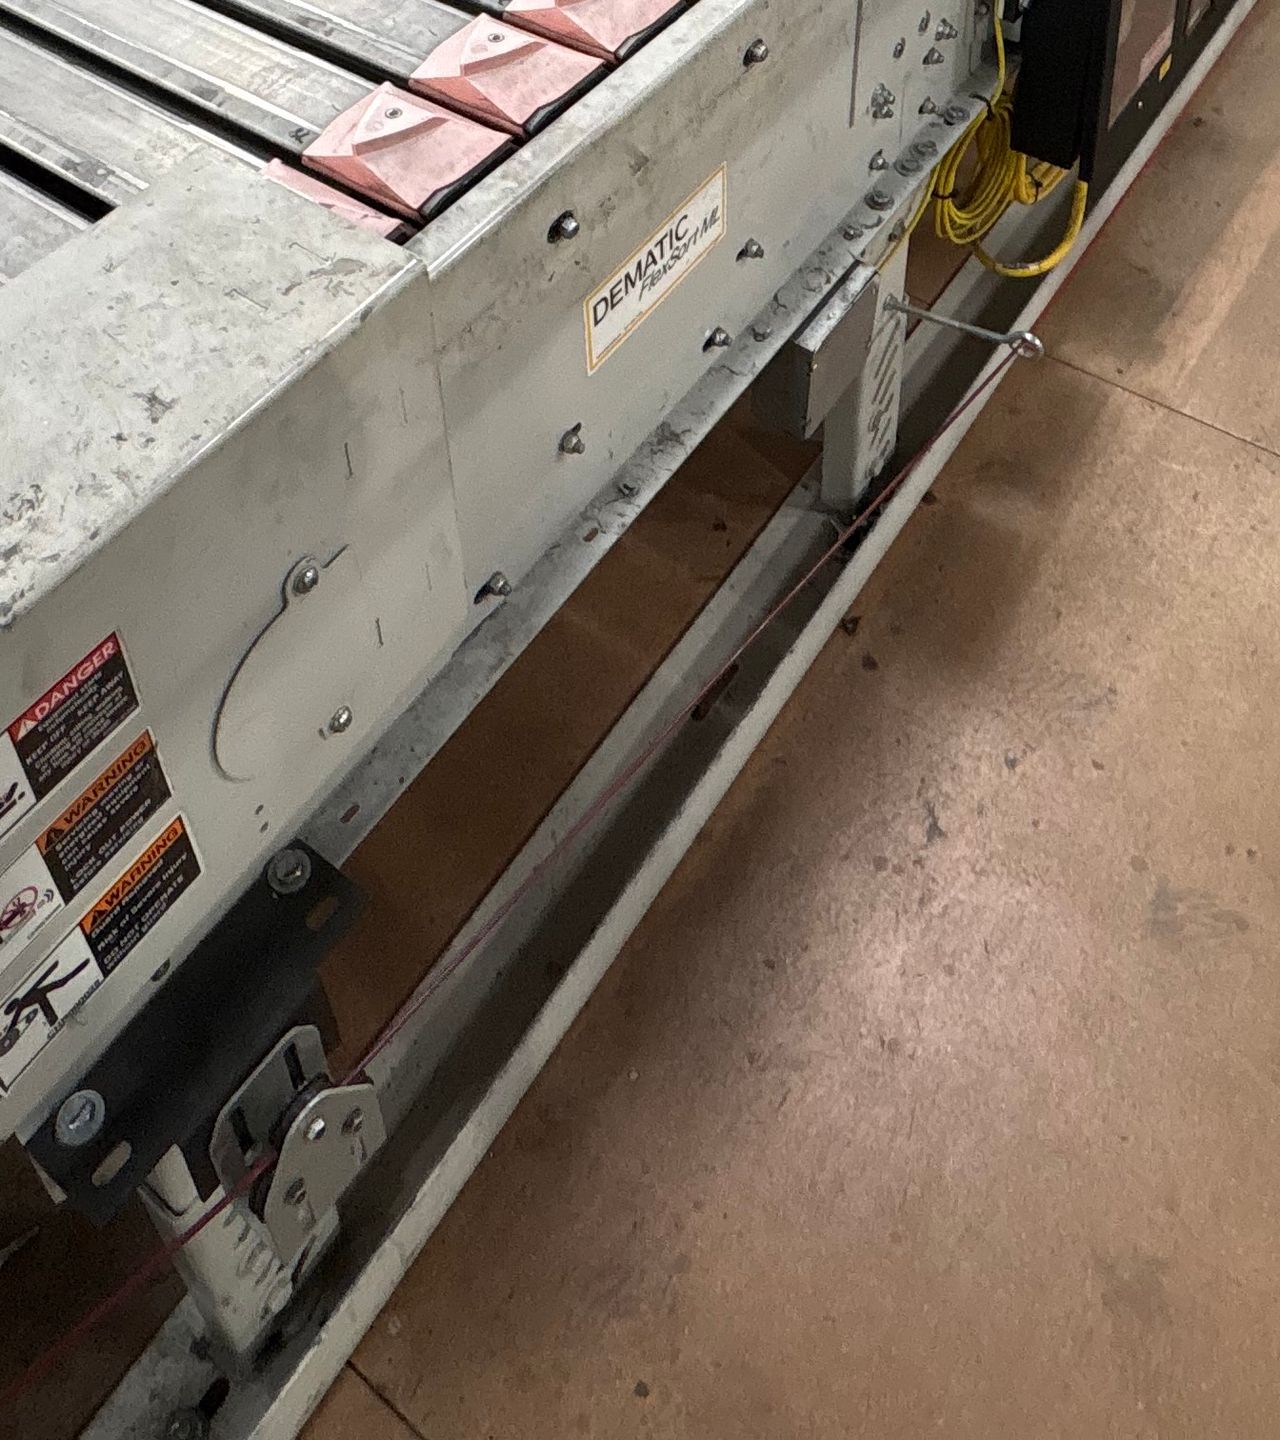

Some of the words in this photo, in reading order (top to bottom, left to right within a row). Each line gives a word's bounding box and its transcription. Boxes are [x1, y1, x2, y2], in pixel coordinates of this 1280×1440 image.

[592, 211, 688, 327] DEMATIC
[638, 224, 698, 302] FlexSort
[25, 740, 49, 766] KEEP
[49, 723, 67, 743] OFF
[76, 692, 100, 718] KEEP
[99, 669, 124, 696] AWAY
[33, 638, 115, 721] DANGER
[63, 738, 146, 828] WARNING
[70, 855, 95, 884] LOCK
[97, 831, 117, 855] OUT
[119, 796, 151, 833] POWER
[104, 825, 178, 908] WARNING
[96, 926, 118, 951] Risk
[118, 913, 129, 927] of
[130, 878, 161, 915] Severe
[103, 945, 119, 965] DO
[119, 923, 139, 947] NOT
[140, 873, 184, 923] OPERATE
